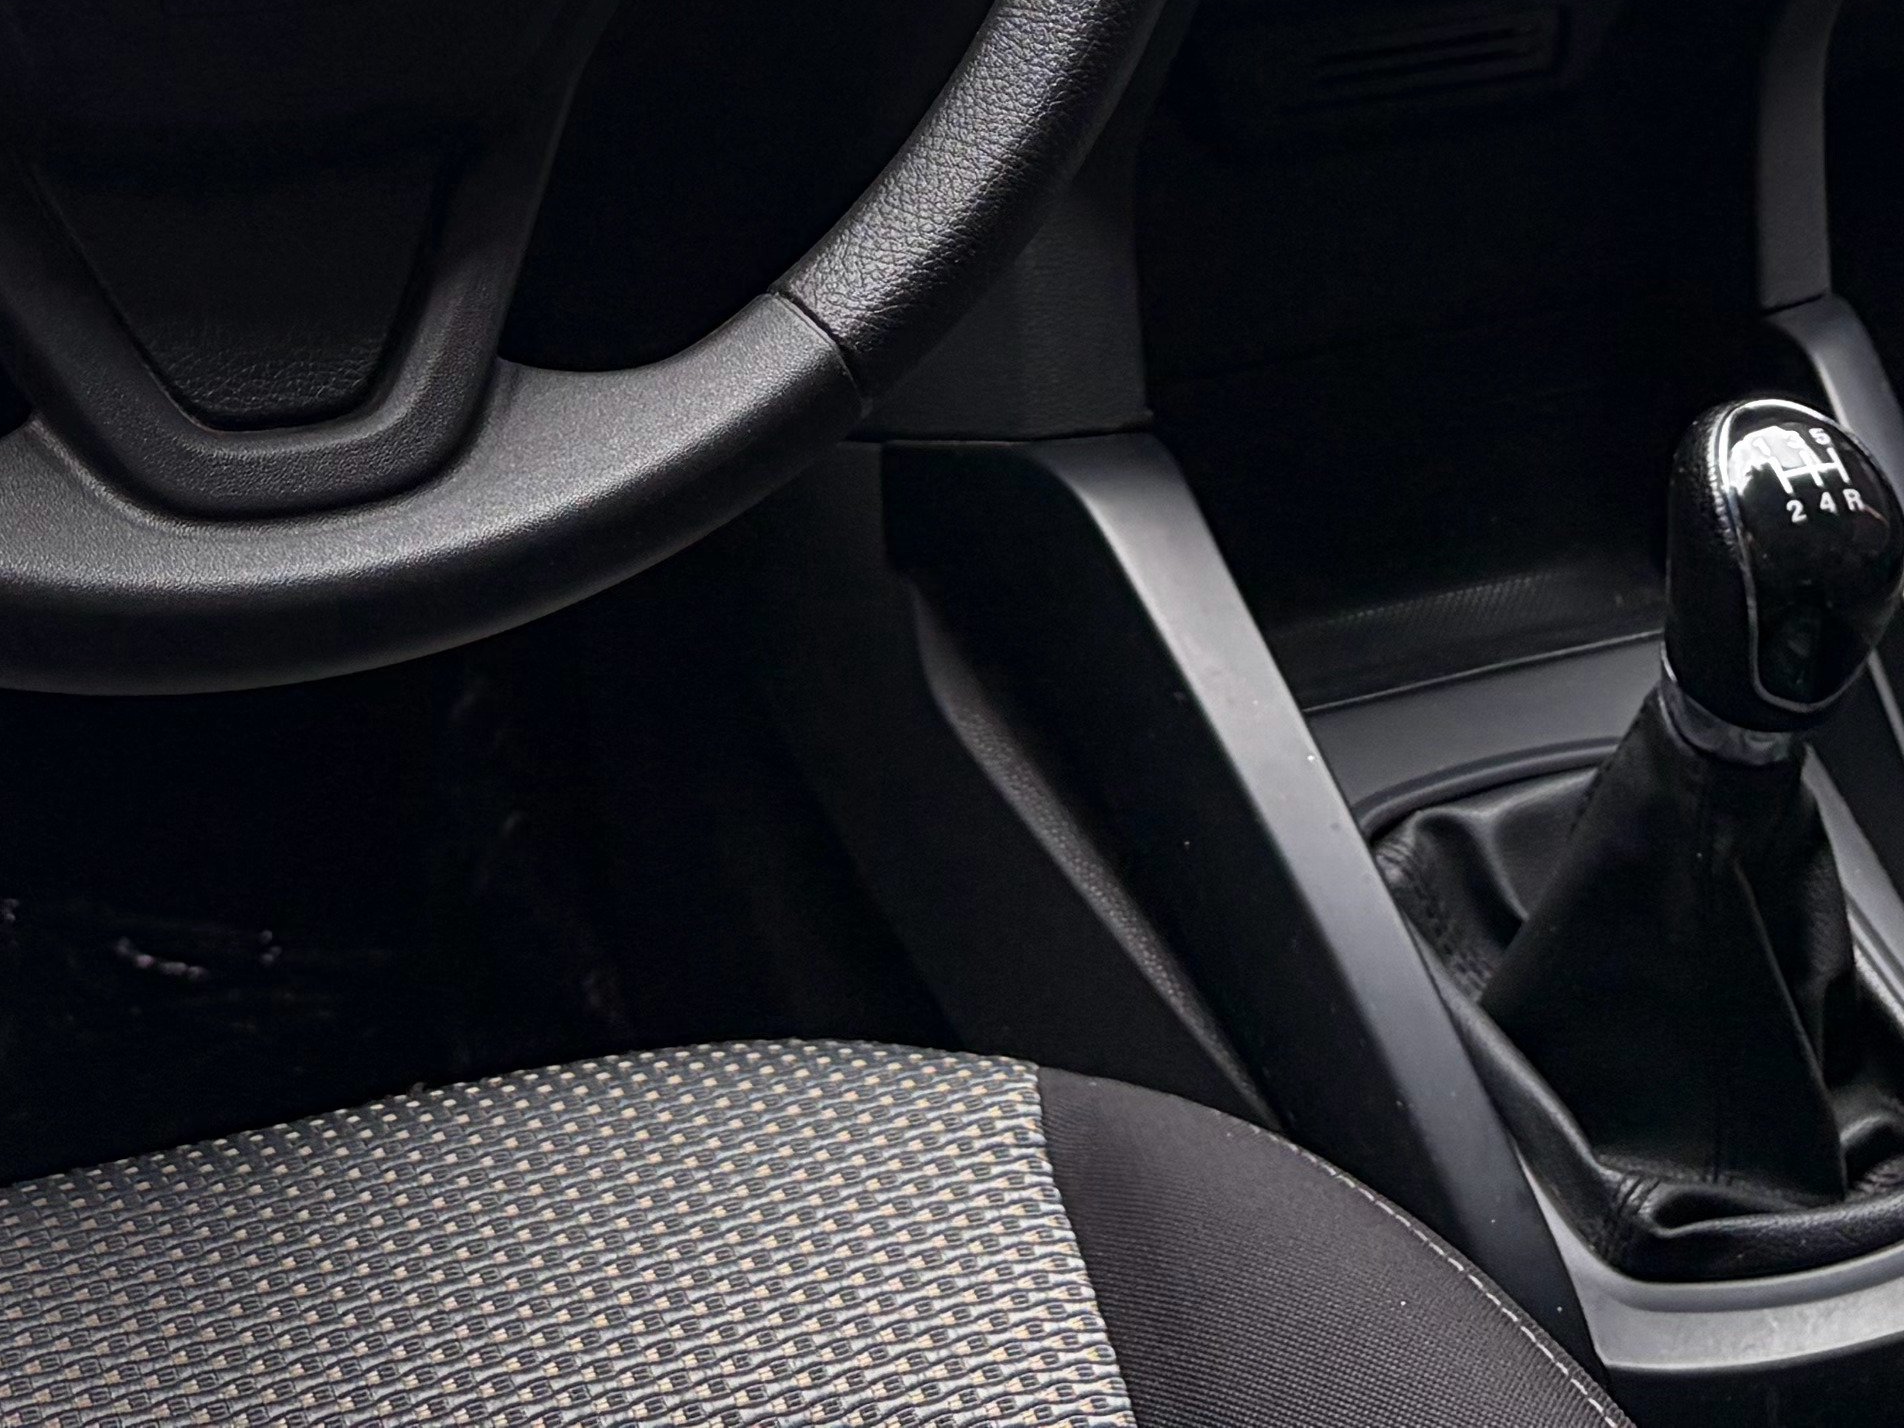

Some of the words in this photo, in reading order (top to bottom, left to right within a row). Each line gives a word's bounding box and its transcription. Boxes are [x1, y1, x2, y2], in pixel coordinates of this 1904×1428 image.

[1808, 427, 1832, 446] 5
[1785, 499, 1808, 524] 2
[1819, 491, 1838, 515] 4
[1842, 488, 1866, 512] R
